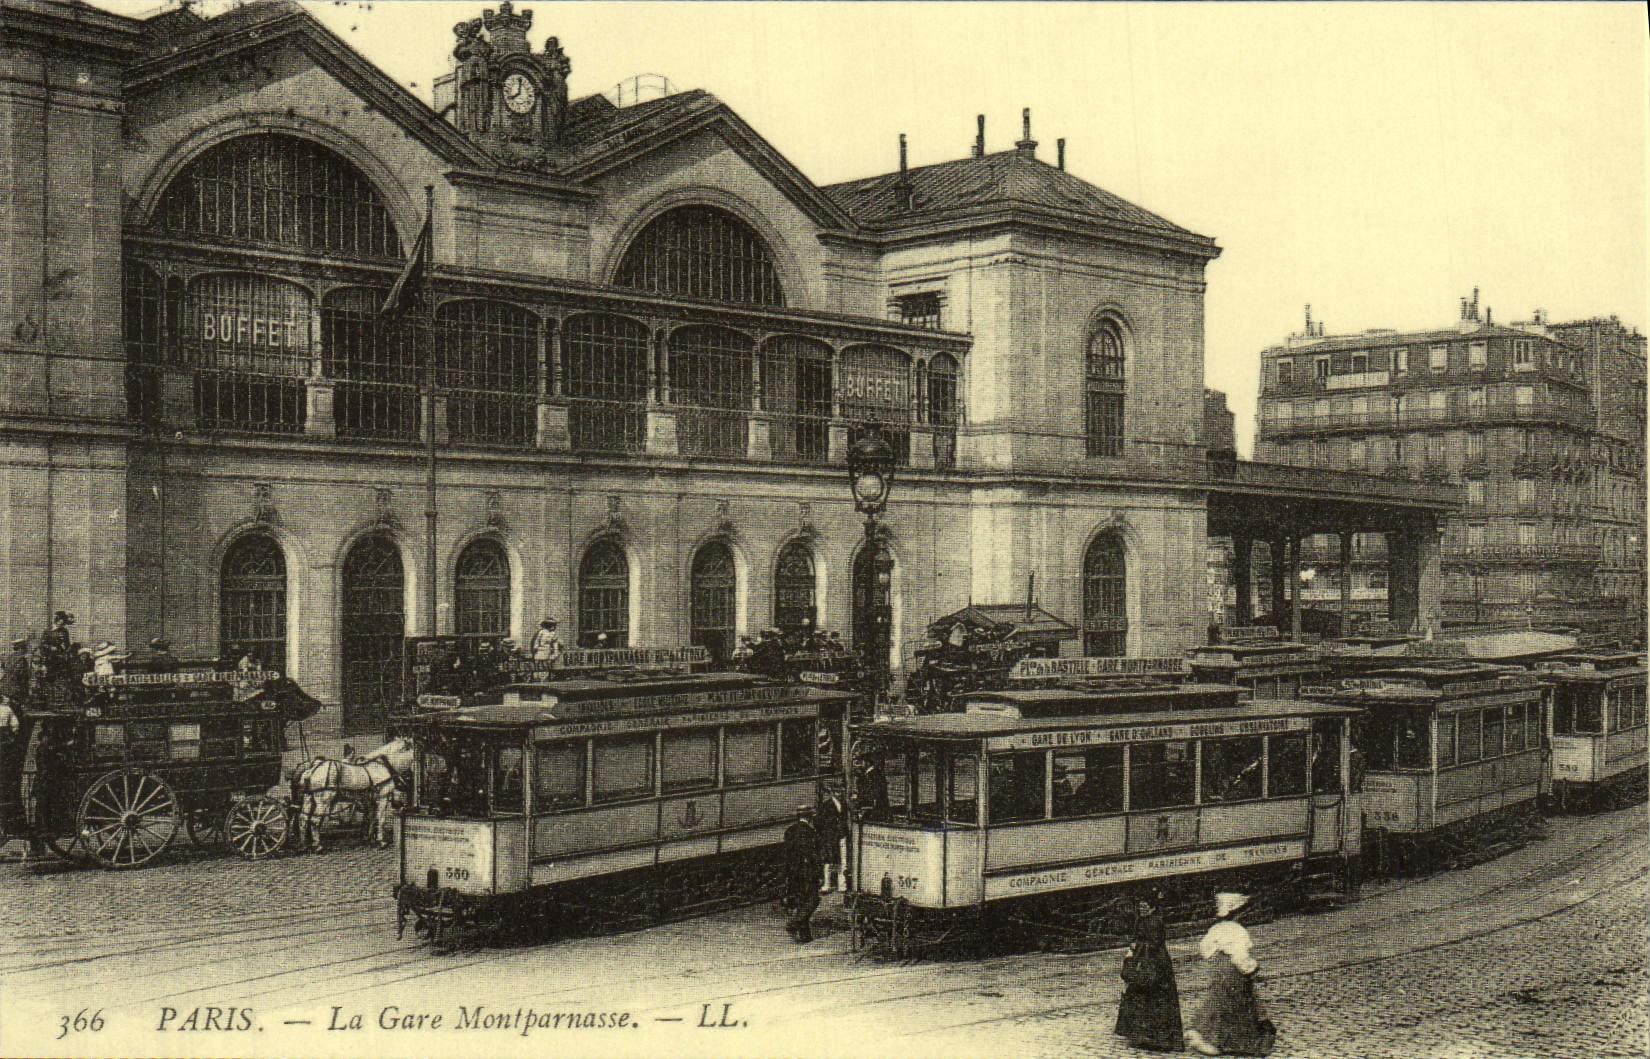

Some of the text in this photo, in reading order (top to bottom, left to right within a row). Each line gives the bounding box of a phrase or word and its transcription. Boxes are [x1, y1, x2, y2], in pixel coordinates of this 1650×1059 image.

[203, 312, 295, 347] BUFFET
[846, 374, 901, 401] BUFFET
[1051, 660, 1090, 675] BASTILLE
[1096, 659, 1118, 674] GARE
[1032, 733, 1053, 746] GARE
[1056, 732, 1067, 745] DE
[1070, 731, 1091, 743] LYON
[1109, 729, 1129, 741] GARE
[1009, 872, 1067, 888] COMPAGNIE
[1215, 853, 1227, 862] DE
